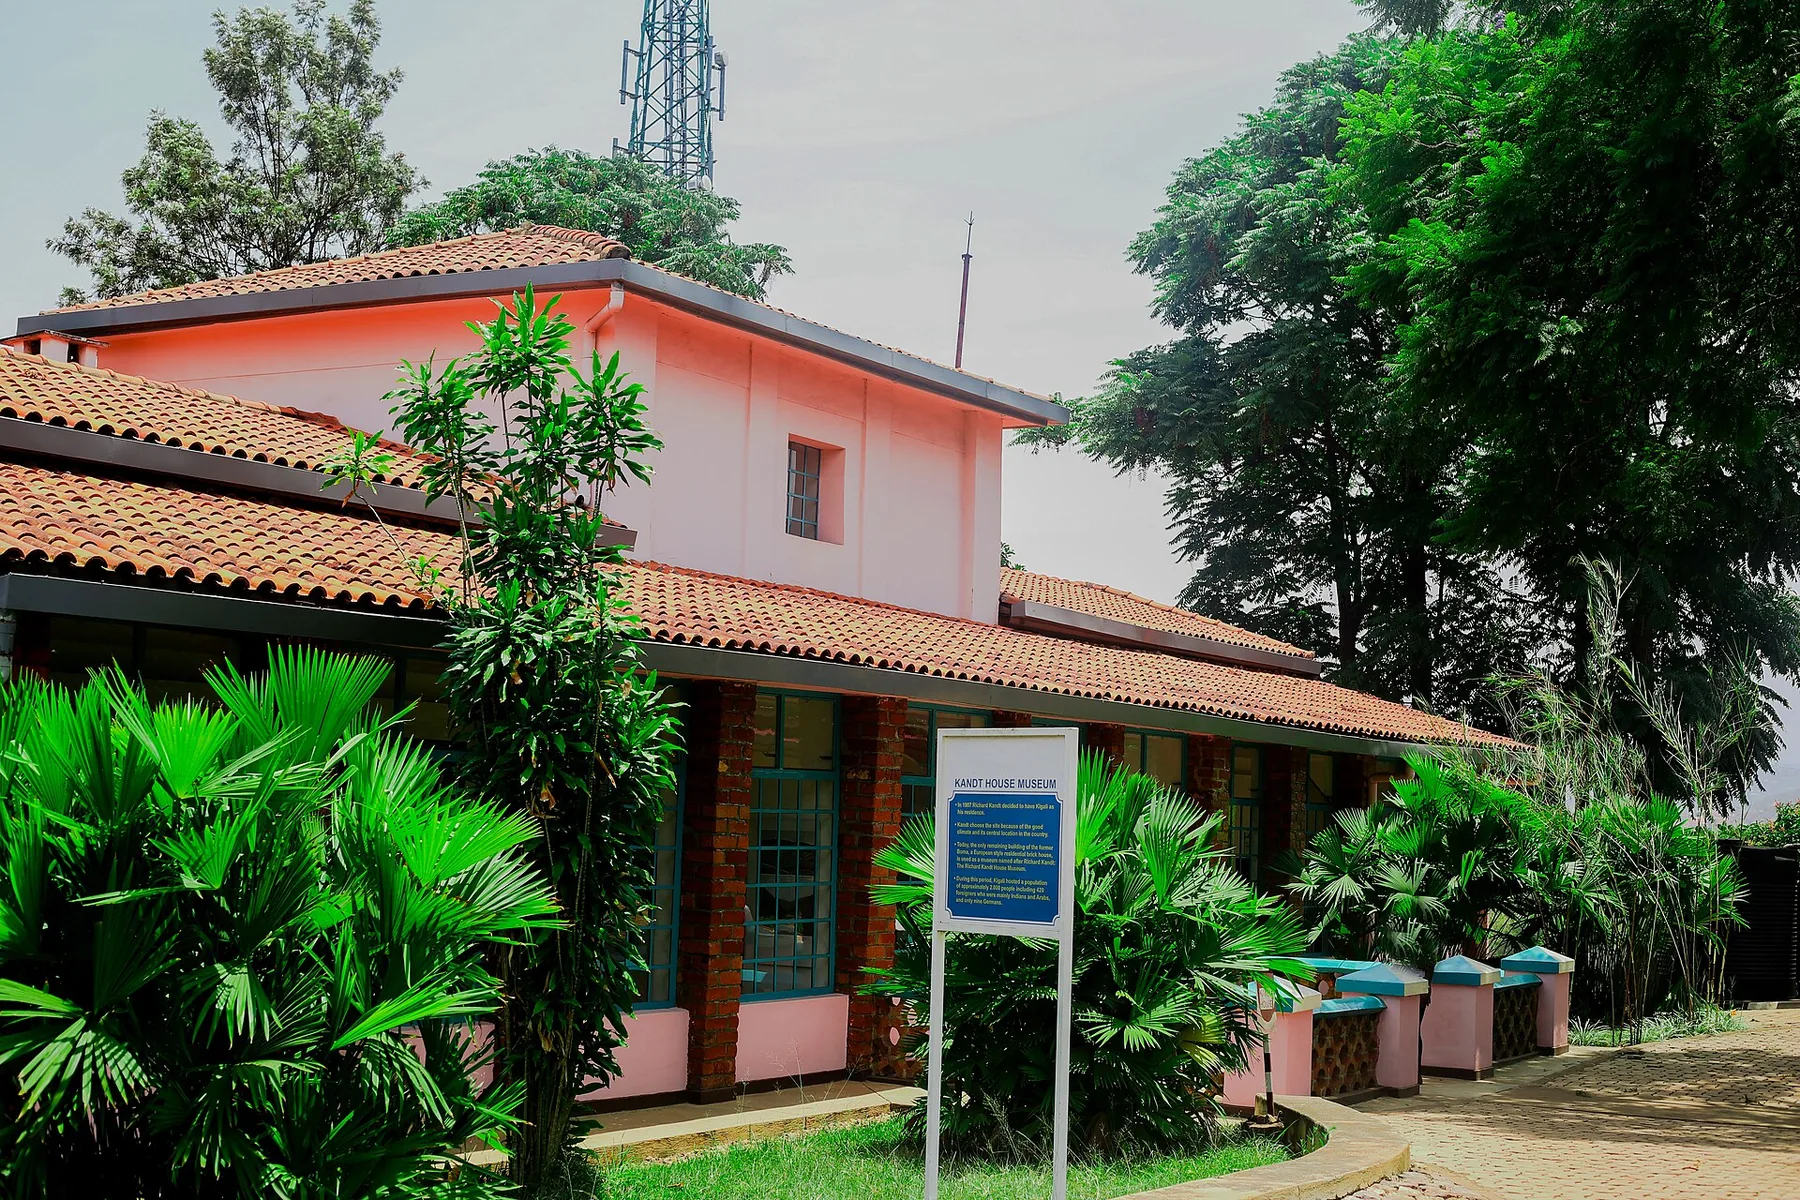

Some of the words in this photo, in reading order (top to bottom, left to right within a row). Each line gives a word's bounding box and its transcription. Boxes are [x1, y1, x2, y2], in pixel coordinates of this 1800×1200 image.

[954, 778, 983, 788] KANDT
[985, 778, 1015, 788] HOUSE
[1018, 779, 1056, 788] MUSEUM
